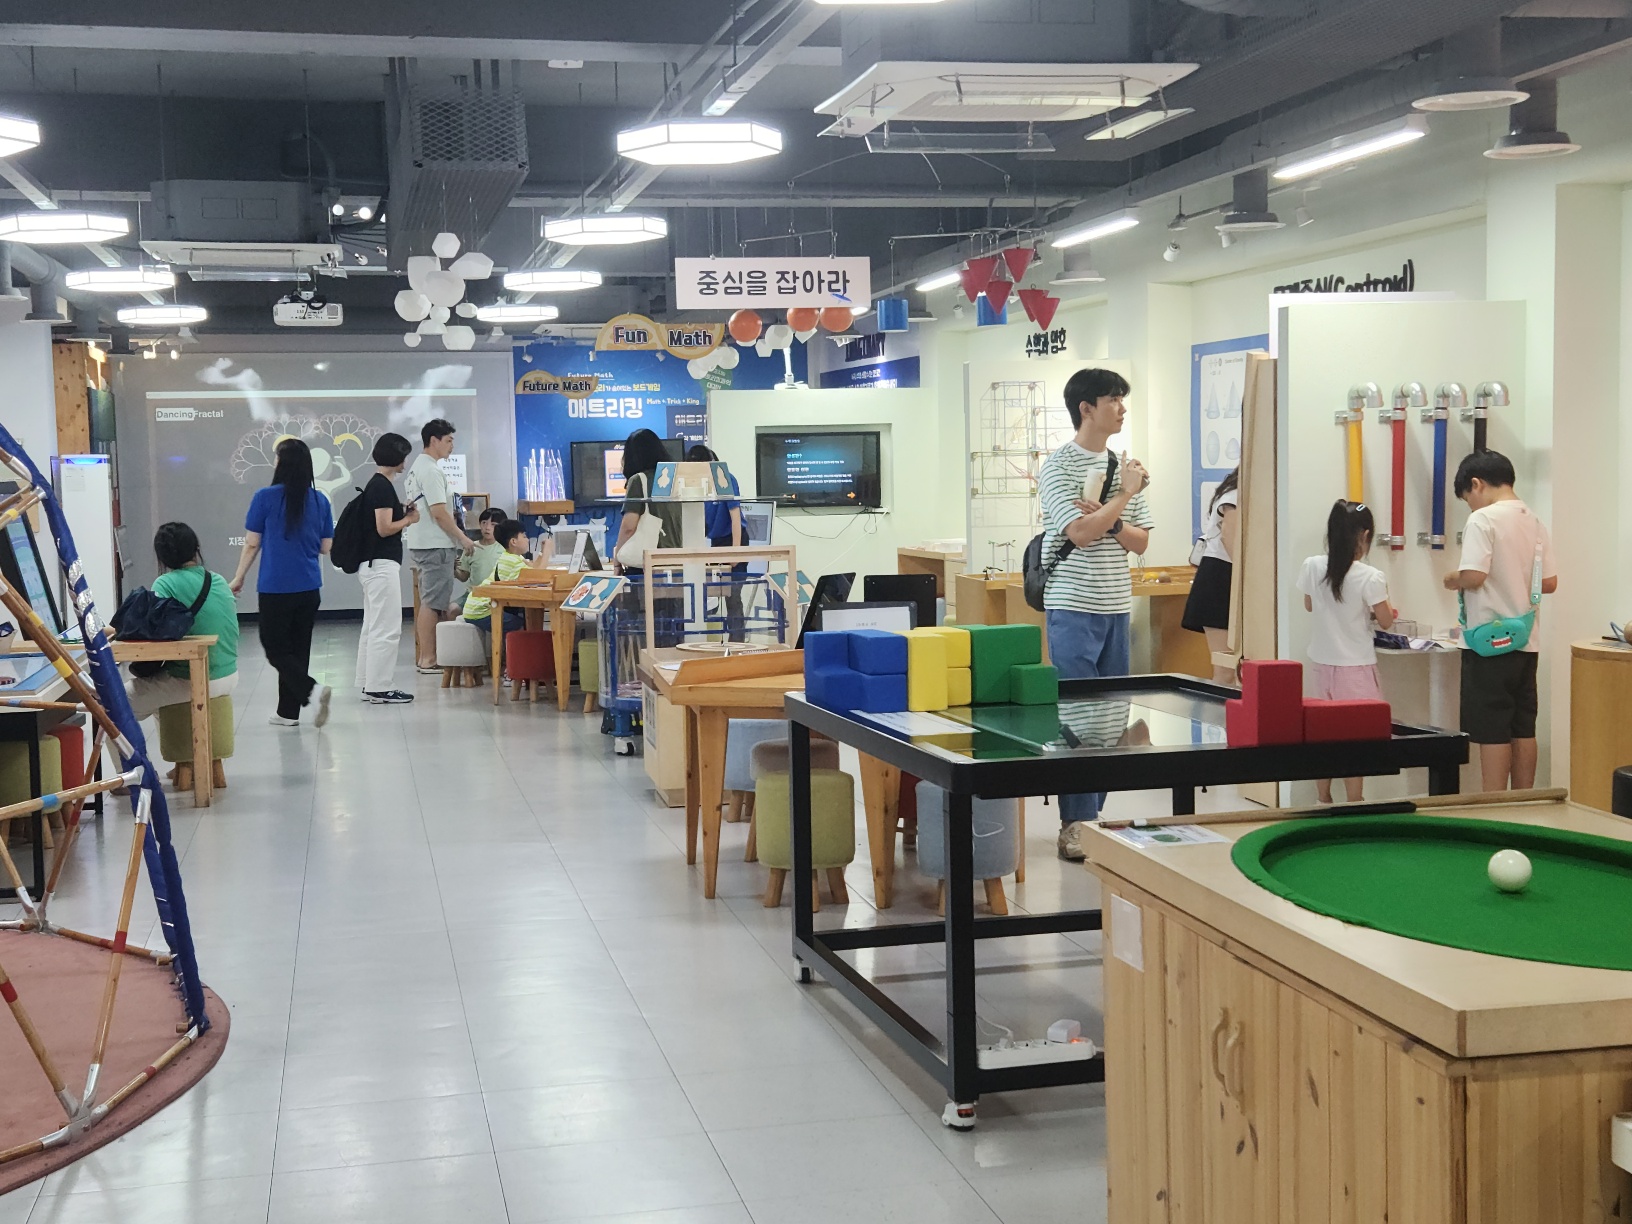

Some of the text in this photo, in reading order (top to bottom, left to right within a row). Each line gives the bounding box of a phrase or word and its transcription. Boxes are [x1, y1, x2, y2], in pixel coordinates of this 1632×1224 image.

[697, 270, 850, 297] 중심을 잡아라
[613, 325, 713, 348] Fun Math
[1025, 327, 1067, 358] 수학과 암호
[522, 378, 592, 392] Future Math
[567, 397, 643, 418] 매트리킹
[646, 397, 662, 405] Math
[686, 397, 700, 406] King
